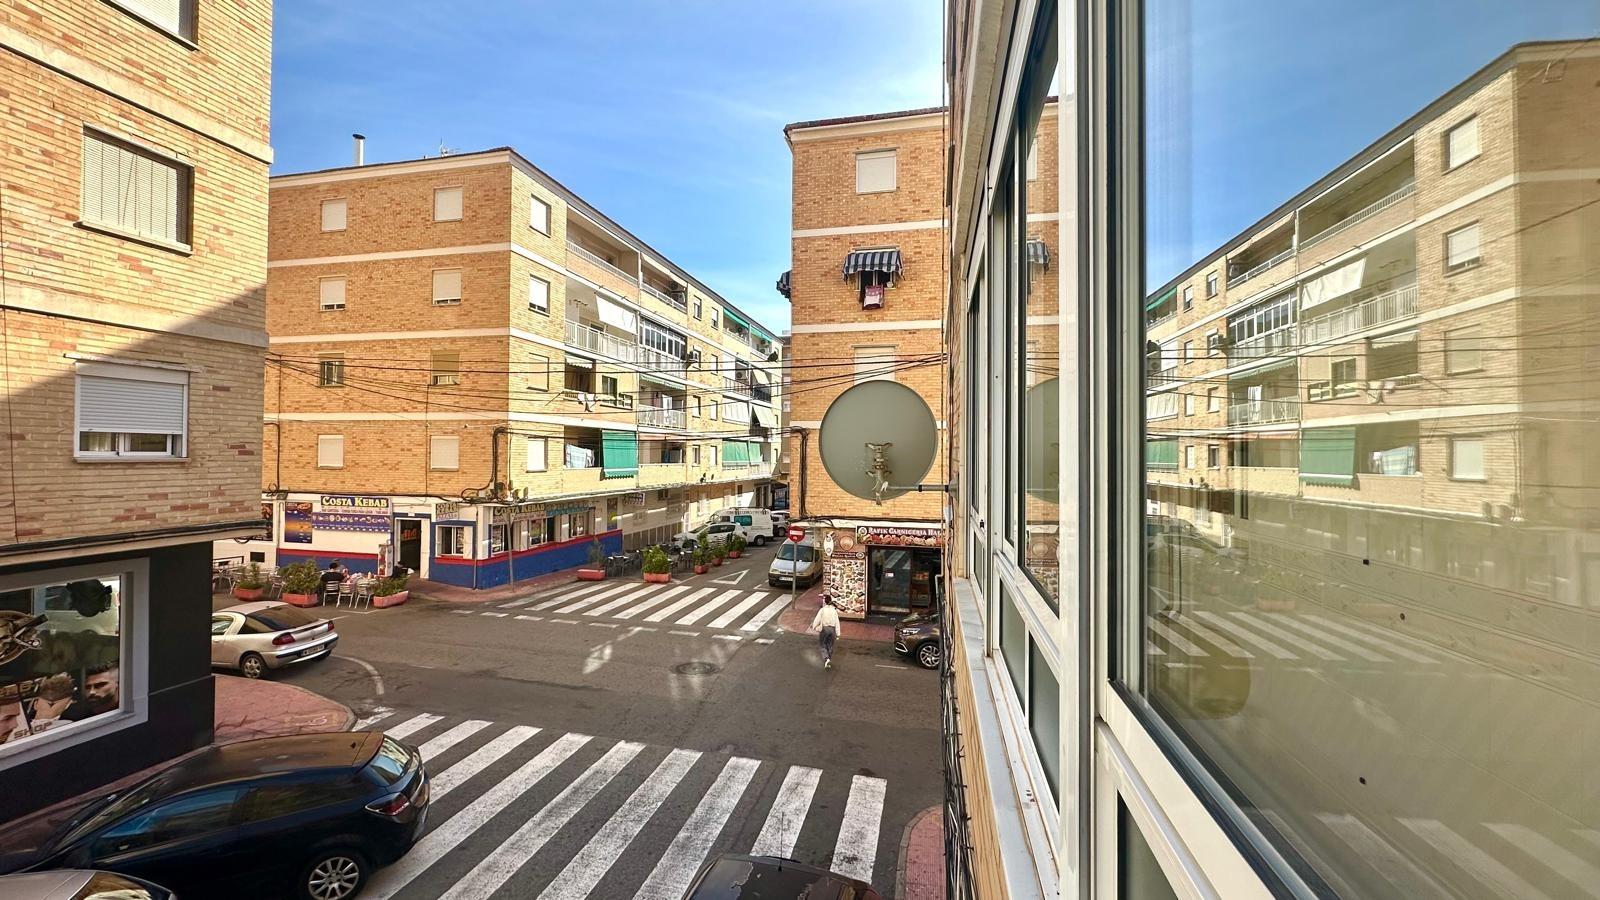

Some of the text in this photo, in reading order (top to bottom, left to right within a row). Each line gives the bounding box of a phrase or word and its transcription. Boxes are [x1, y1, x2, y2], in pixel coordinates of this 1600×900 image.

[322, 496, 388, 508] COSTA KEBAB
[521, 502, 546, 513] KEBAB
[868, 527, 888, 535] RAFIK
[888, 527, 927, 537] CARNICERIA
[14, 721, 53, 739] SHOP
